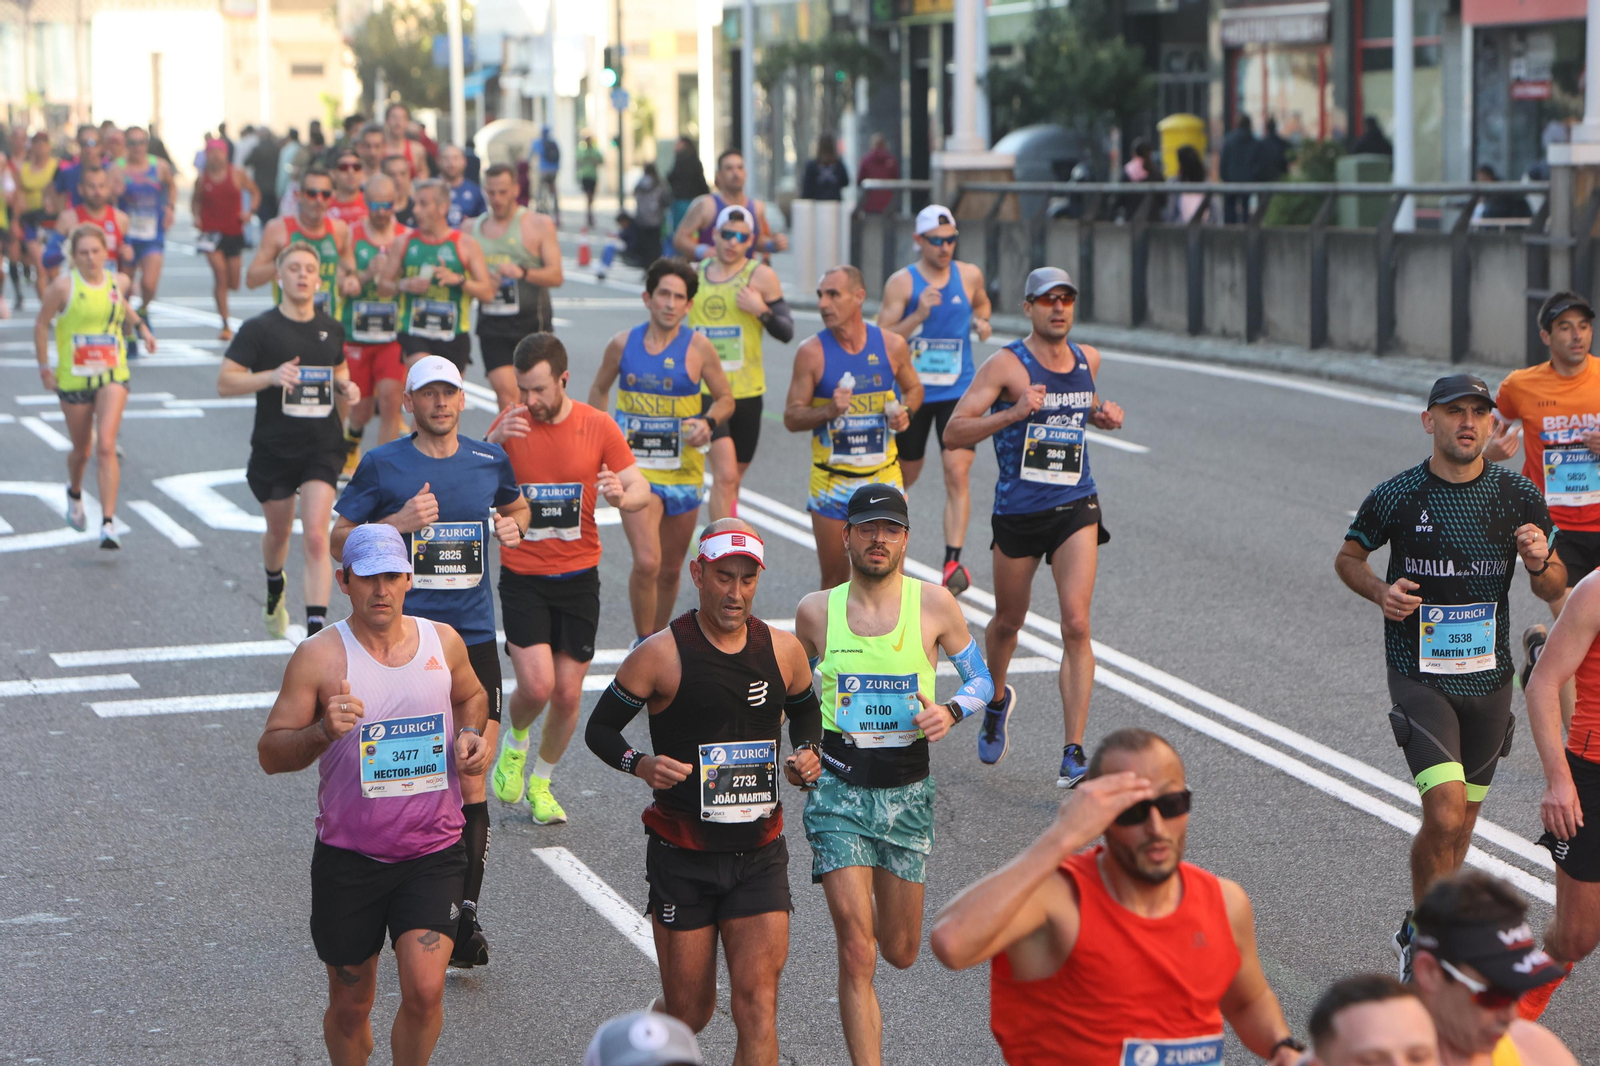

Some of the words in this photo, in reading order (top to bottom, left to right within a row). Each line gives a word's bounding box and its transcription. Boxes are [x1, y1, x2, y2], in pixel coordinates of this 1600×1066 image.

[624, 393, 681, 417] OSSET
[643, 422, 673, 430] ZURICH
[848, 417, 878, 426] ZURICH
[1049, 430, 1079, 440] ZURICH
[1046, 449, 1066, 460] 2843
[1567, 472, 1586, 481] 5835
[541, 488, 575, 497] ZURICH
[439, 528, 476, 537] ZURICH
[1416, 525, 1433, 533] BY2
[439, 550, 462, 560] 2825
[434, 564, 466, 573] THOMAS
[1405, 557, 1455, 577] CAZALLA
[1449, 608, 1486, 620] ZURICH
[1448, 633, 1472, 644] 3538
[1431, 647, 1464, 657] MARTÍN
[1474, 646, 1486, 655] TEO
[866, 680, 910, 690] ZURICH
[865, 705, 892, 716] 6100
[391, 721, 435, 735] ZURICH
[859, 721, 898, 731] WILLIAM
[392, 749, 419, 762] 3477
[732, 748, 769, 760] ZURICH
[374, 763, 437, 780] HECTOR-HUGO
[732, 775, 757, 787] 2732
[712, 793, 736, 805] JOÃO
[739, 791, 772, 804] MARTINS
[1165, 1045, 1218, 1066] ZURICH
